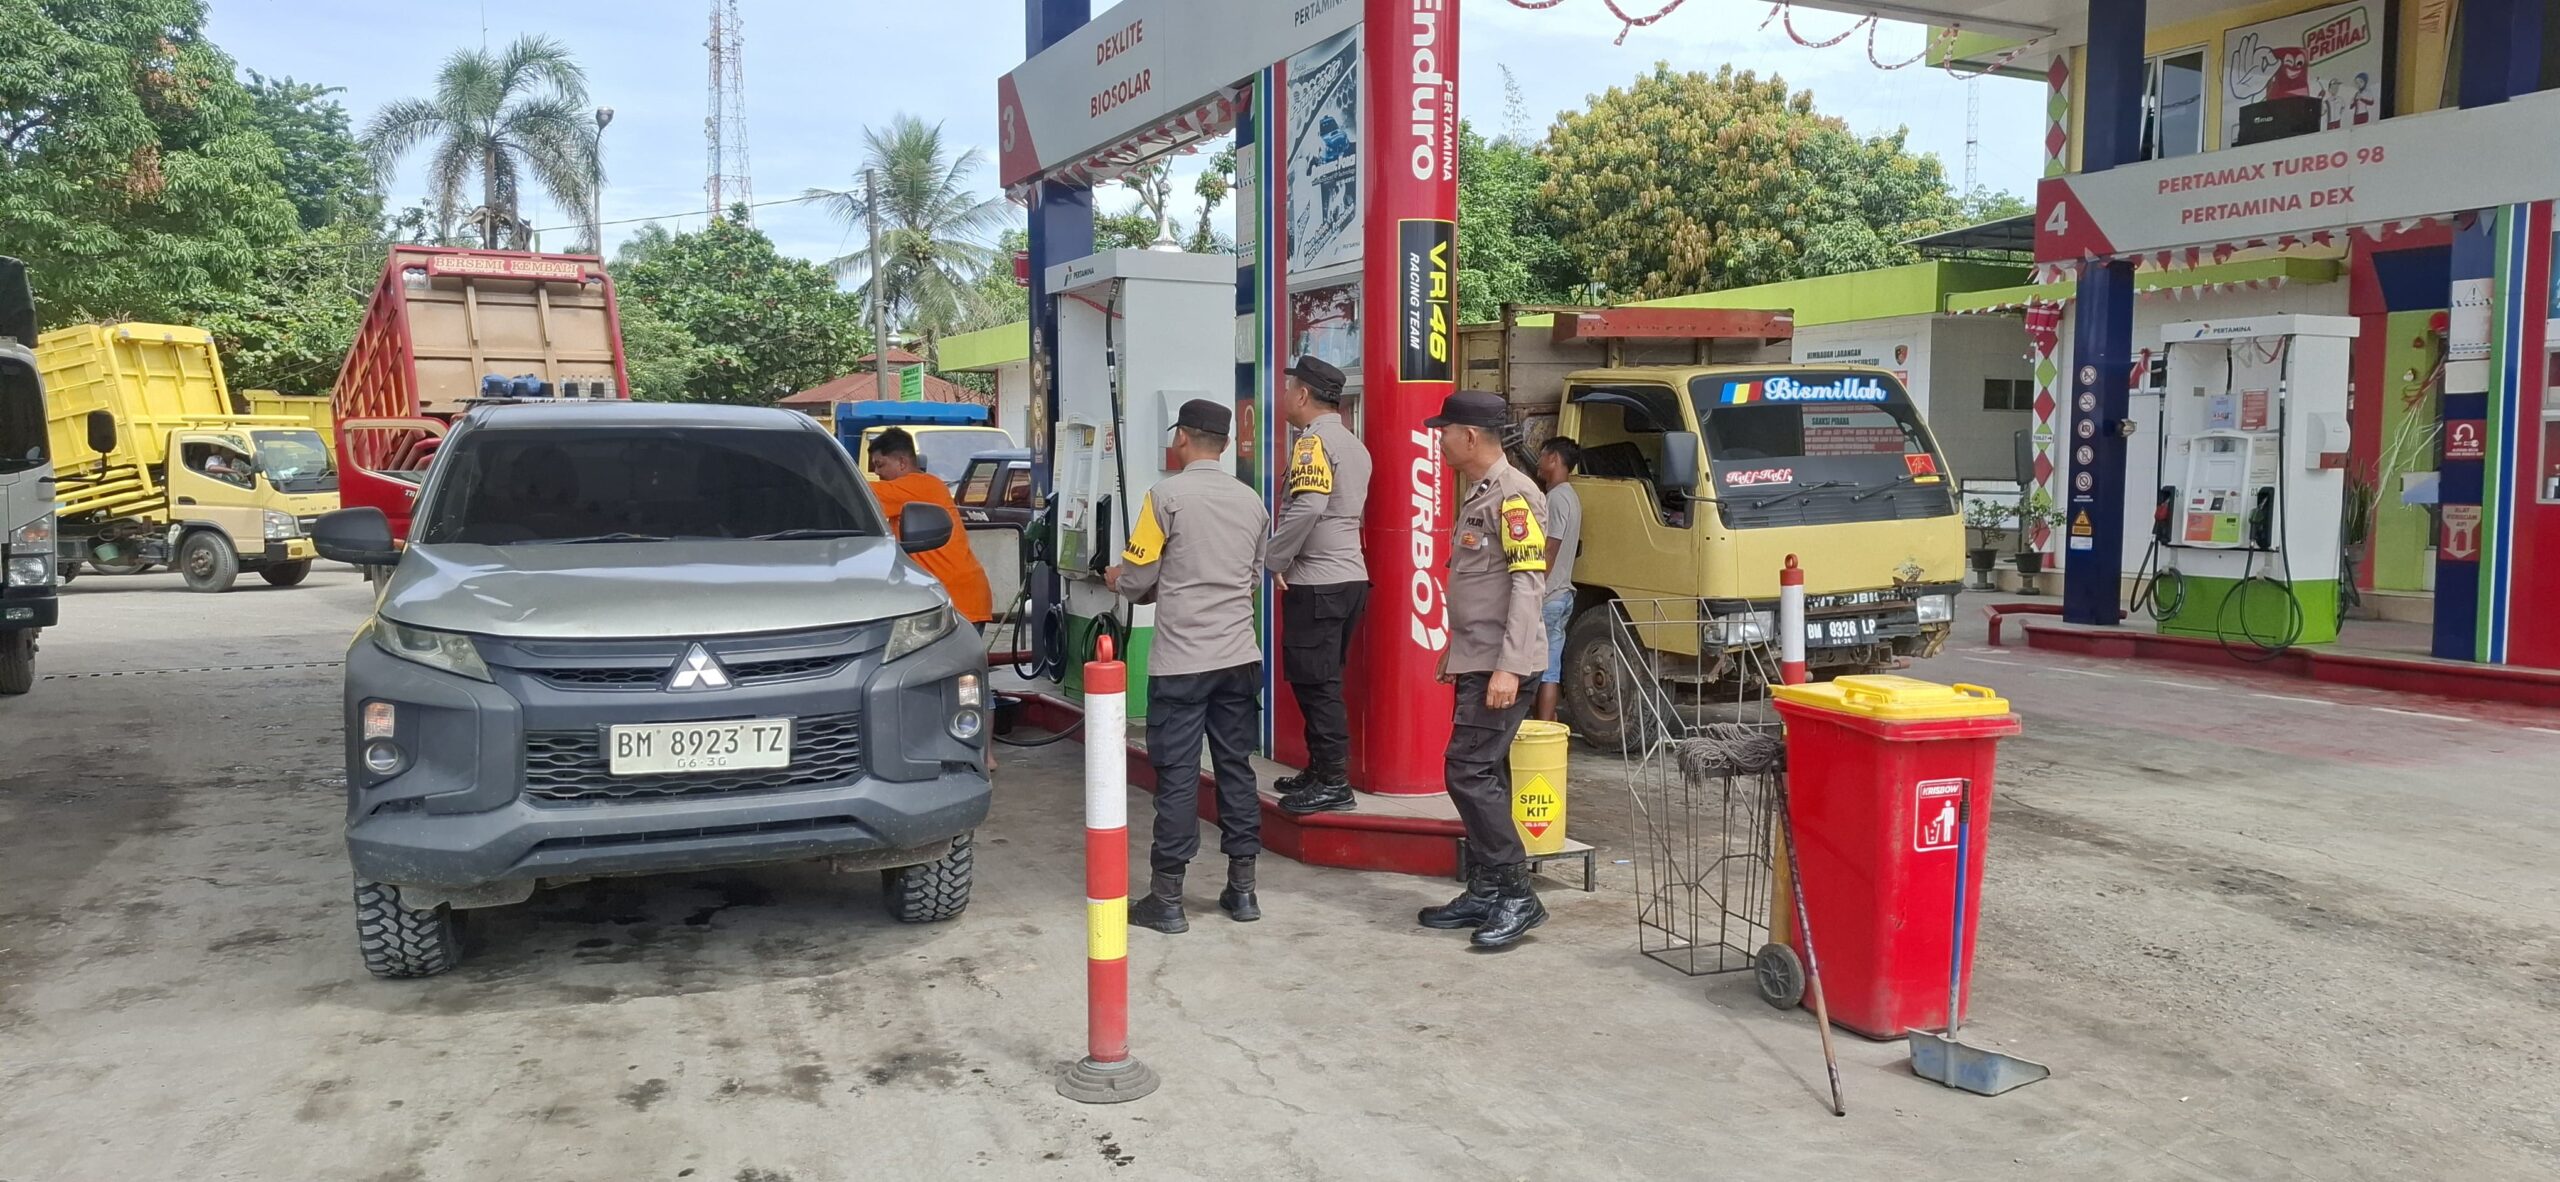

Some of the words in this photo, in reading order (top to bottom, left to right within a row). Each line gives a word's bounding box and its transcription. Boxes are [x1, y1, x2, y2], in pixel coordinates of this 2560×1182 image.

[1294, 0, 1347, 27] PERTAMI
[2307, 16, 2351, 48] PASTI
[1096, 18, 1143, 66] DEXLITE
[2310, 24, 2366, 61] PRIMA!
[1090, 68, 1151, 119] BIOSOLAR
[1003, 105, 1016, 153] 3
[1443, 79, 1454, 182] PERTAMINA
[2158, 163, 2265, 194] PERTAMAX
[2272, 151, 2348, 177] TURBO
[2356, 146, 2385, 165] 98
[2045, 201, 2068, 236] 4
[2181, 194, 2302, 224] PERTAMINA
[2310, 186, 2355, 208] DEX
[435, 257, 504, 272] BERSEMI
[511, 260, 579, 274] KEMBALI
[1409, 252, 1420, 306] RACING
[1409, 308, 1420, 350] TEAM
[1764, 376, 1886, 401] Bismillah
[1433, 427, 1443, 518] PERTAMAX
[1411, 427, 1434, 615] TURBO
[1807, 623, 1823, 640] BM
[1861, 618, 1876, 635] LP
[618, 731, 652, 758] BM
[671, 729, 739, 756] 8923
[753, 727, 784, 752] TZ
[1520, 794, 1554, 804] SPILL
[1922, 784, 1960, 796] KRISBOW
[1526, 807, 1549, 817] KIT
